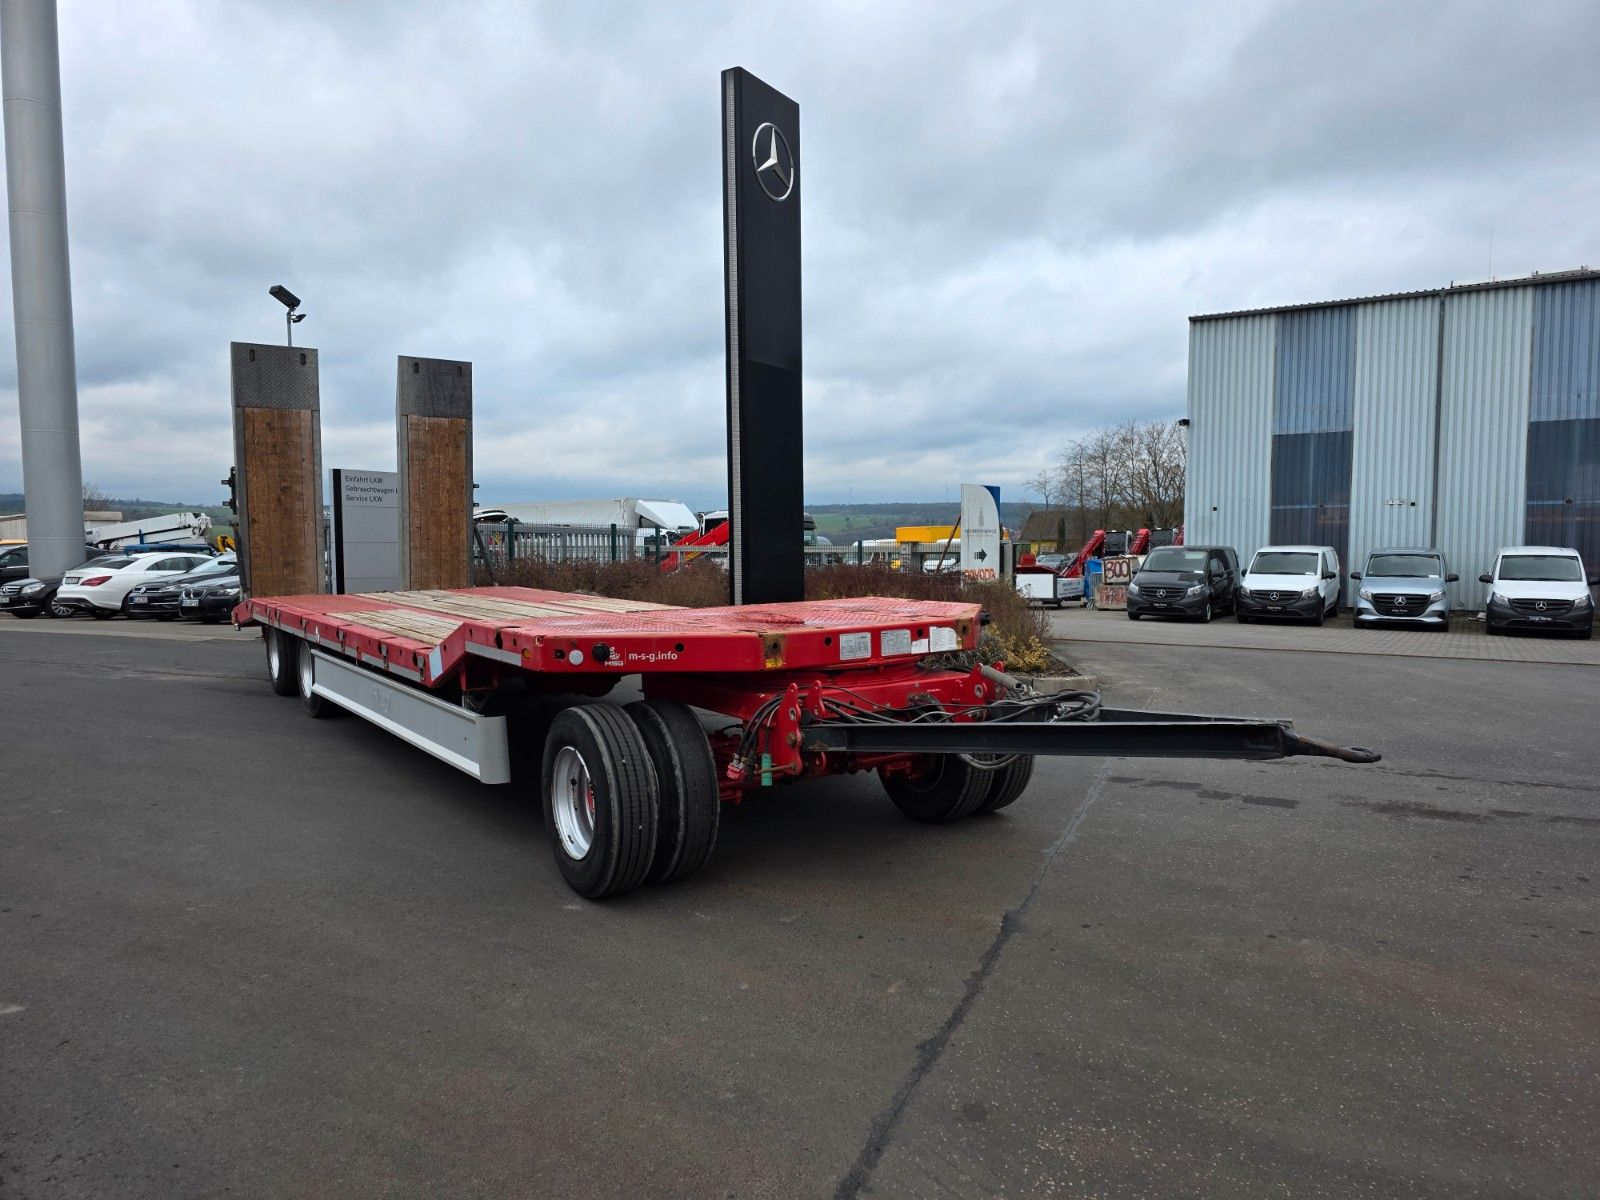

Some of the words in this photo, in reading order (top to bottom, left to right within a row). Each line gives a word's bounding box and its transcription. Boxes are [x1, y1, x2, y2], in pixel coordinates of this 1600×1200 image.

[345, 475, 368, 483] Einfahrt
[345, 485, 394, 495] Gebrauchtwagen
[628, 651, 678, 662] m-s-g.info
